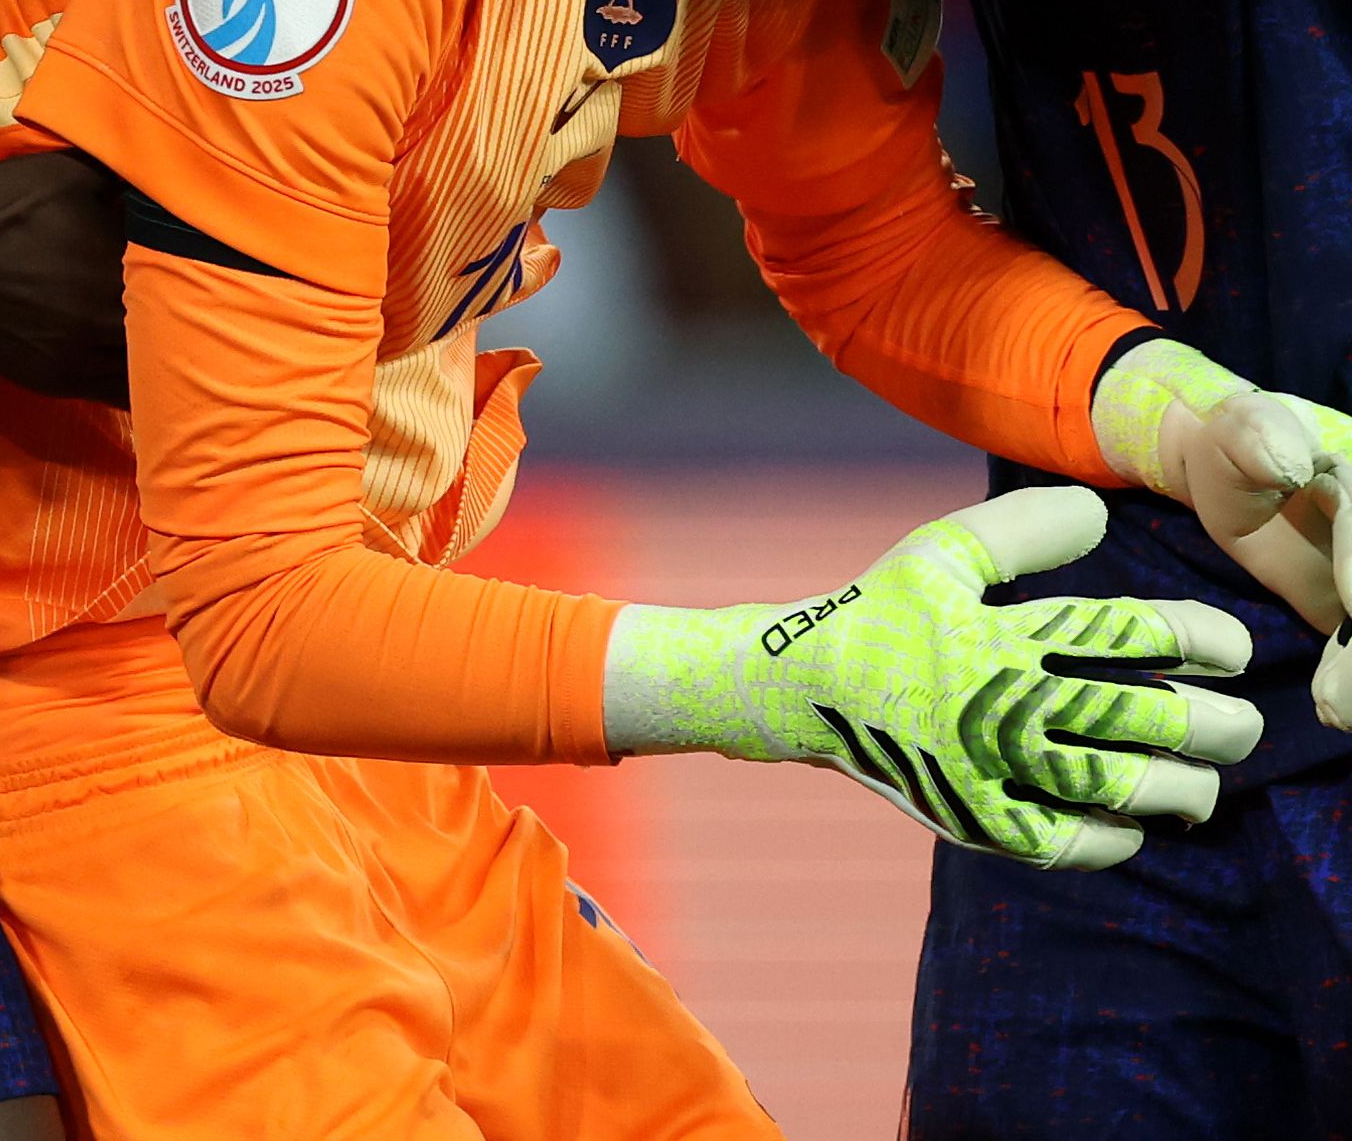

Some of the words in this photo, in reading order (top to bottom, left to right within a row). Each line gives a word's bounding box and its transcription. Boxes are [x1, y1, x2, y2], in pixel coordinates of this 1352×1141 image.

[169, 11, 246, 93] SWITZERLAND
[251, 76, 294, 94] 2025
[1074, 71, 1205, 313] 13
[761, 584, 862, 657] PRED
